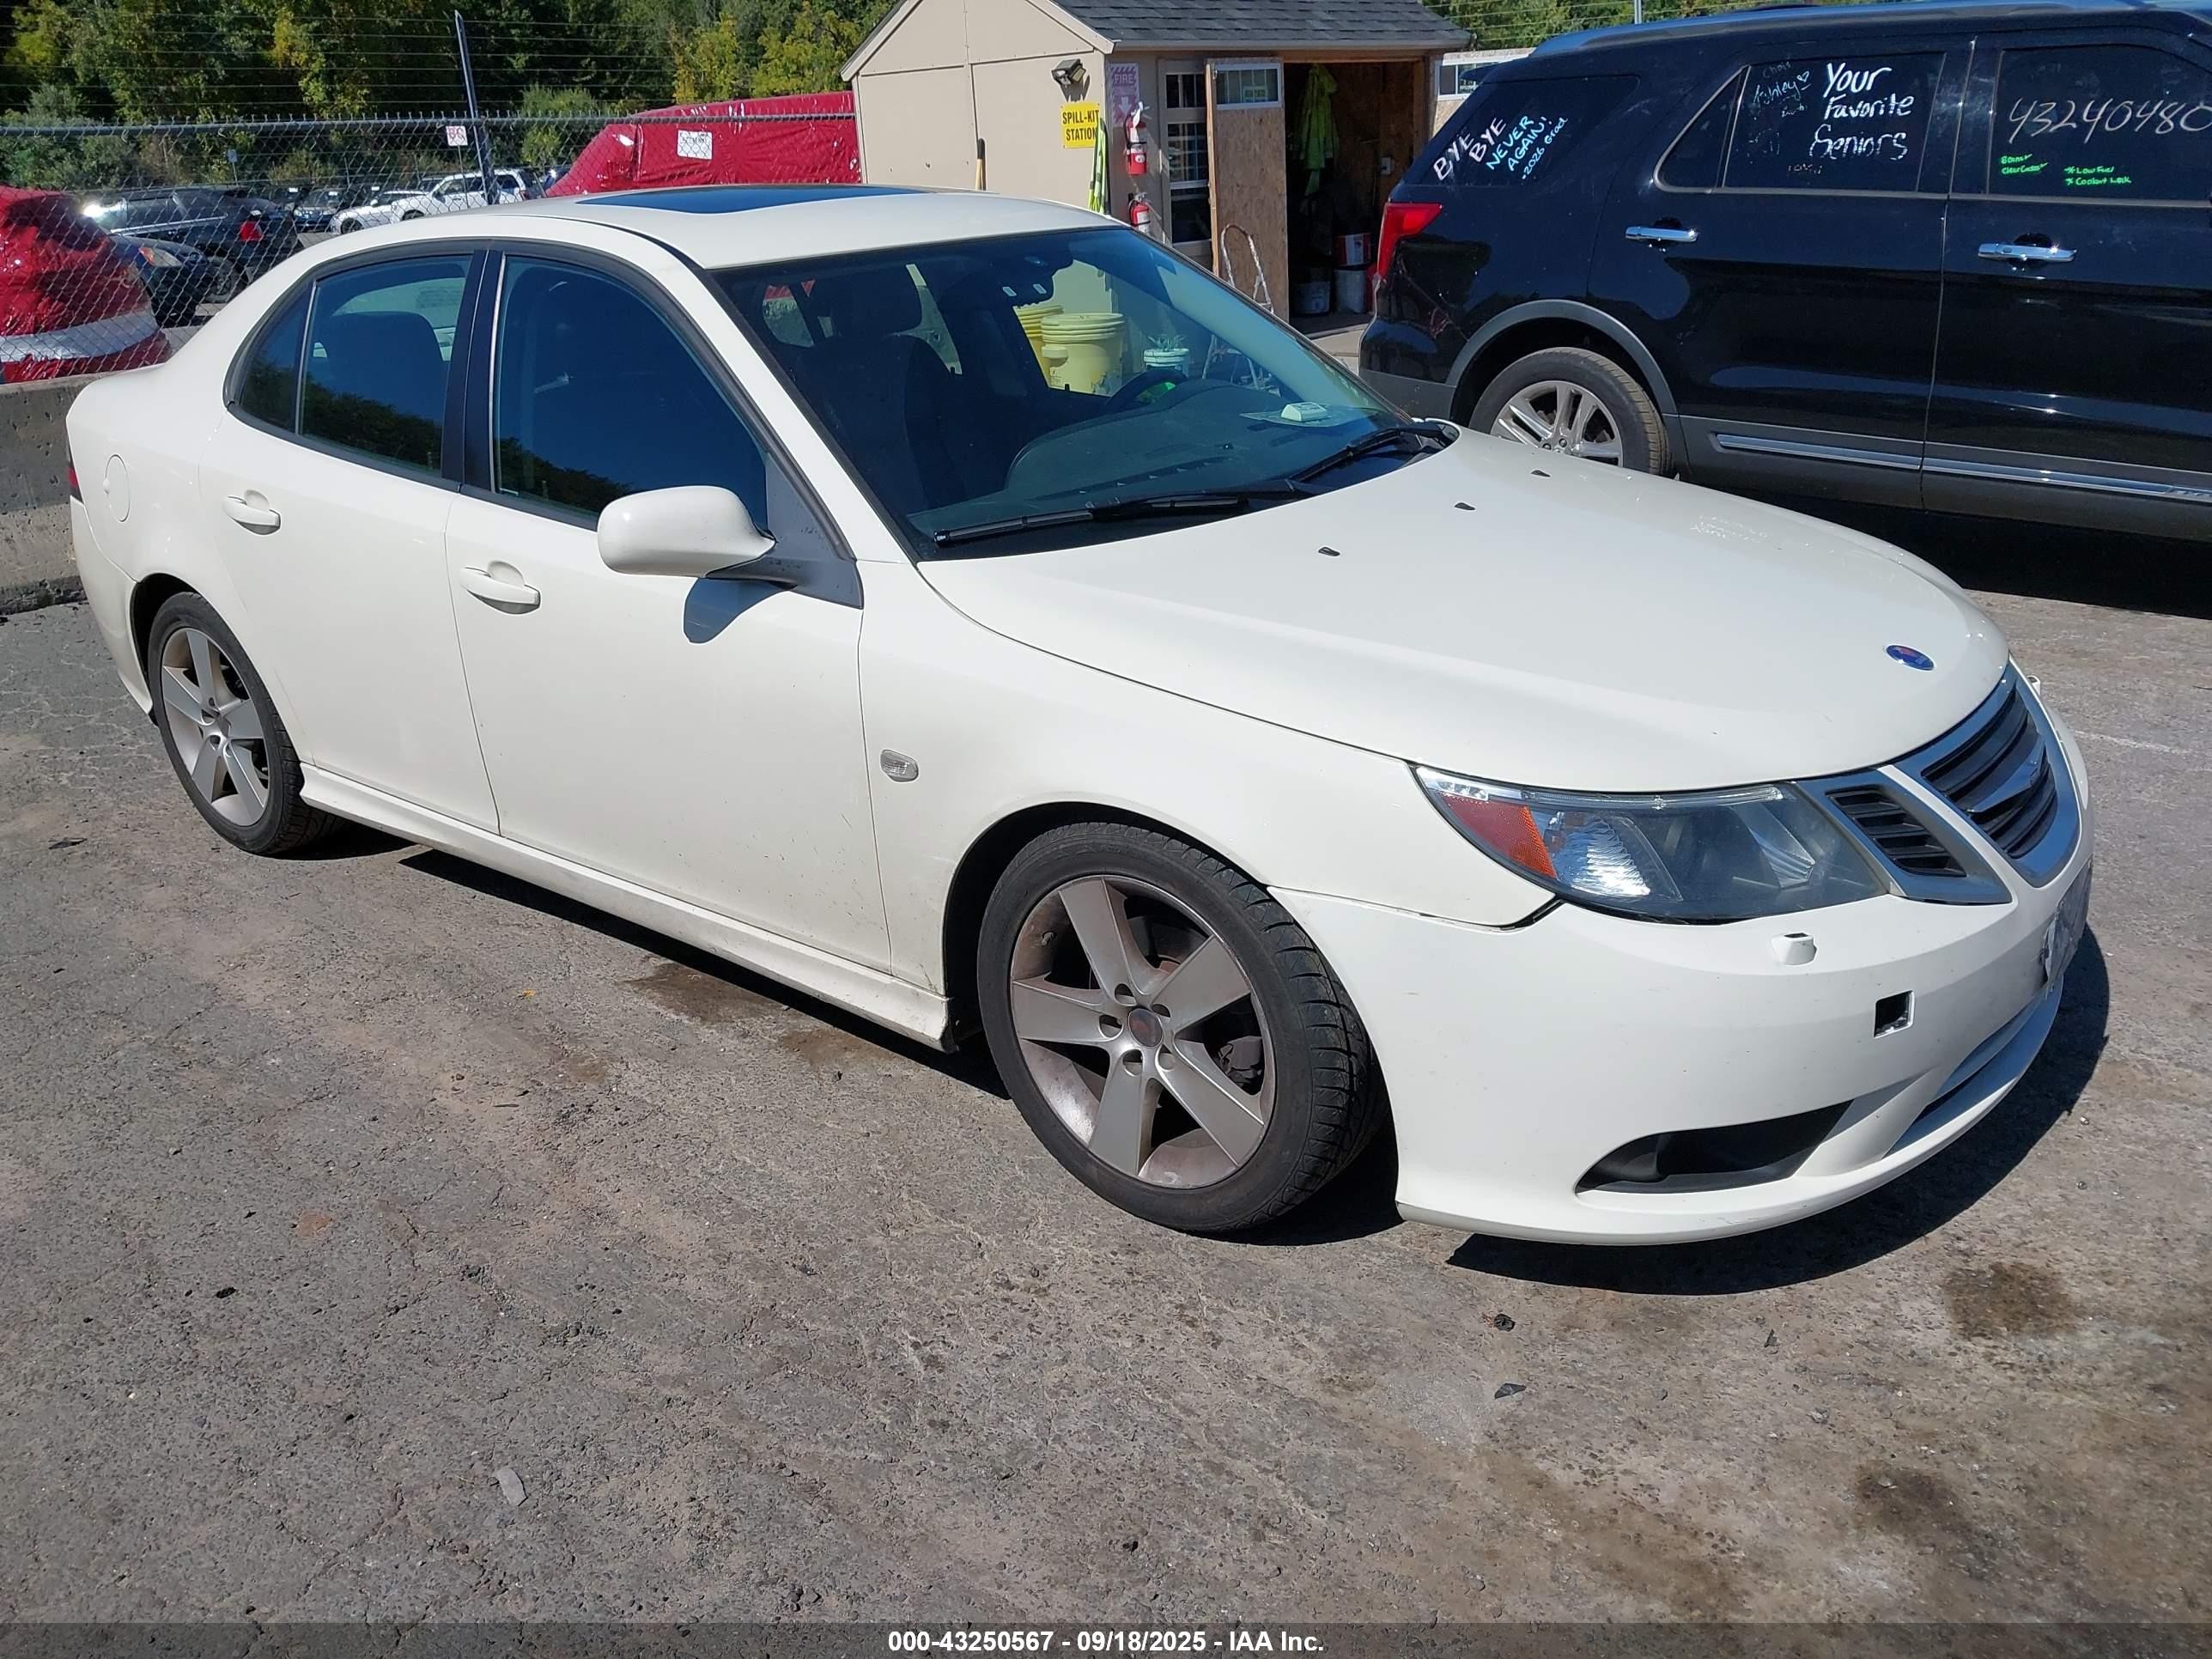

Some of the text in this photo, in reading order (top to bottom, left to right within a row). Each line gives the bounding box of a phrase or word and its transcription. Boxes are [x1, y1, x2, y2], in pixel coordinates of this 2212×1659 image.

[1114, 74, 1133, 83] FIRE
[1823, 62, 1893, 99] Your
[1062, 110, 1099, 125] SPILL-KIT
[1823, 94, 1915, 120] Favorite
[2008, 97, 2212, 144] 43240480
[1432, 132, 1474, 180] BYE
[1468, 117, 1506, 162] BYE
[1486, 115, 1534, 170] NEVER
[1507, 116, 1553, 171] AGAIN!
[1809, 123, 1909, 161] Seniors
